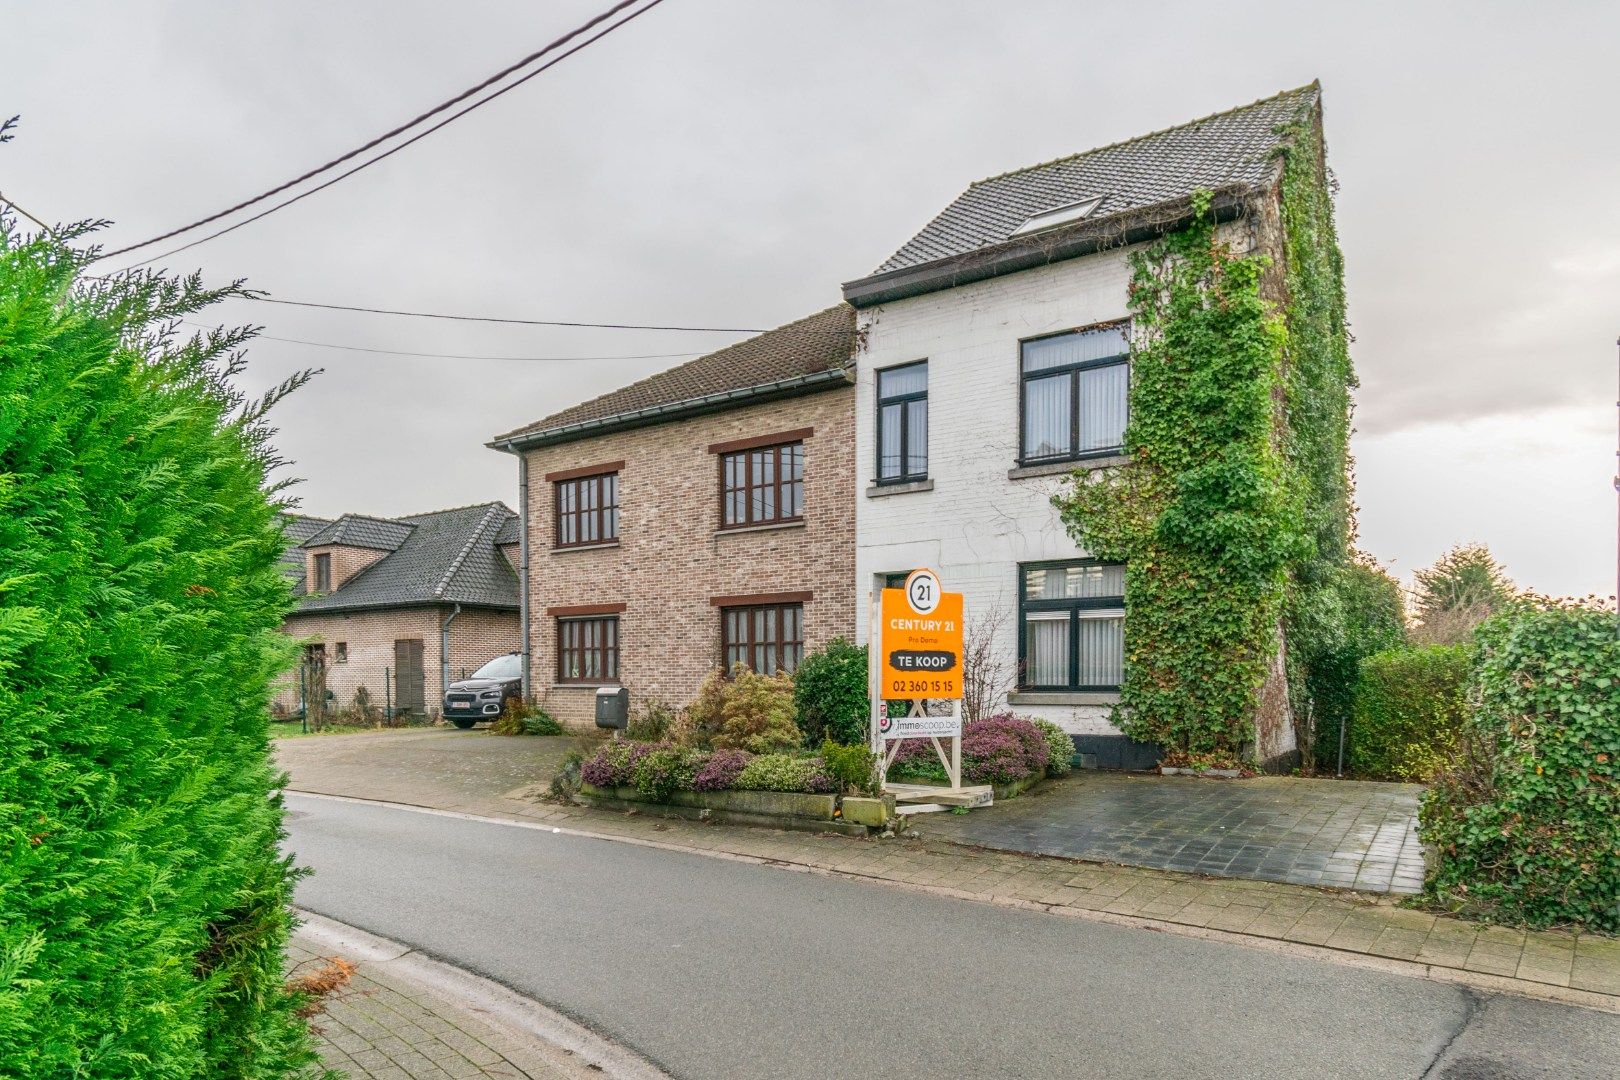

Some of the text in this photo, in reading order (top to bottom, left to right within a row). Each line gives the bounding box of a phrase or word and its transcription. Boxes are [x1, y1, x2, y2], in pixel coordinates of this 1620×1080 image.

[917, 585, 931, 601] 21
[890, 618, 955, 632] CENTURY 21
[898, 656, 947, 667] TE KOOP
[893, 680, 953, 692] 02 360 15 15
